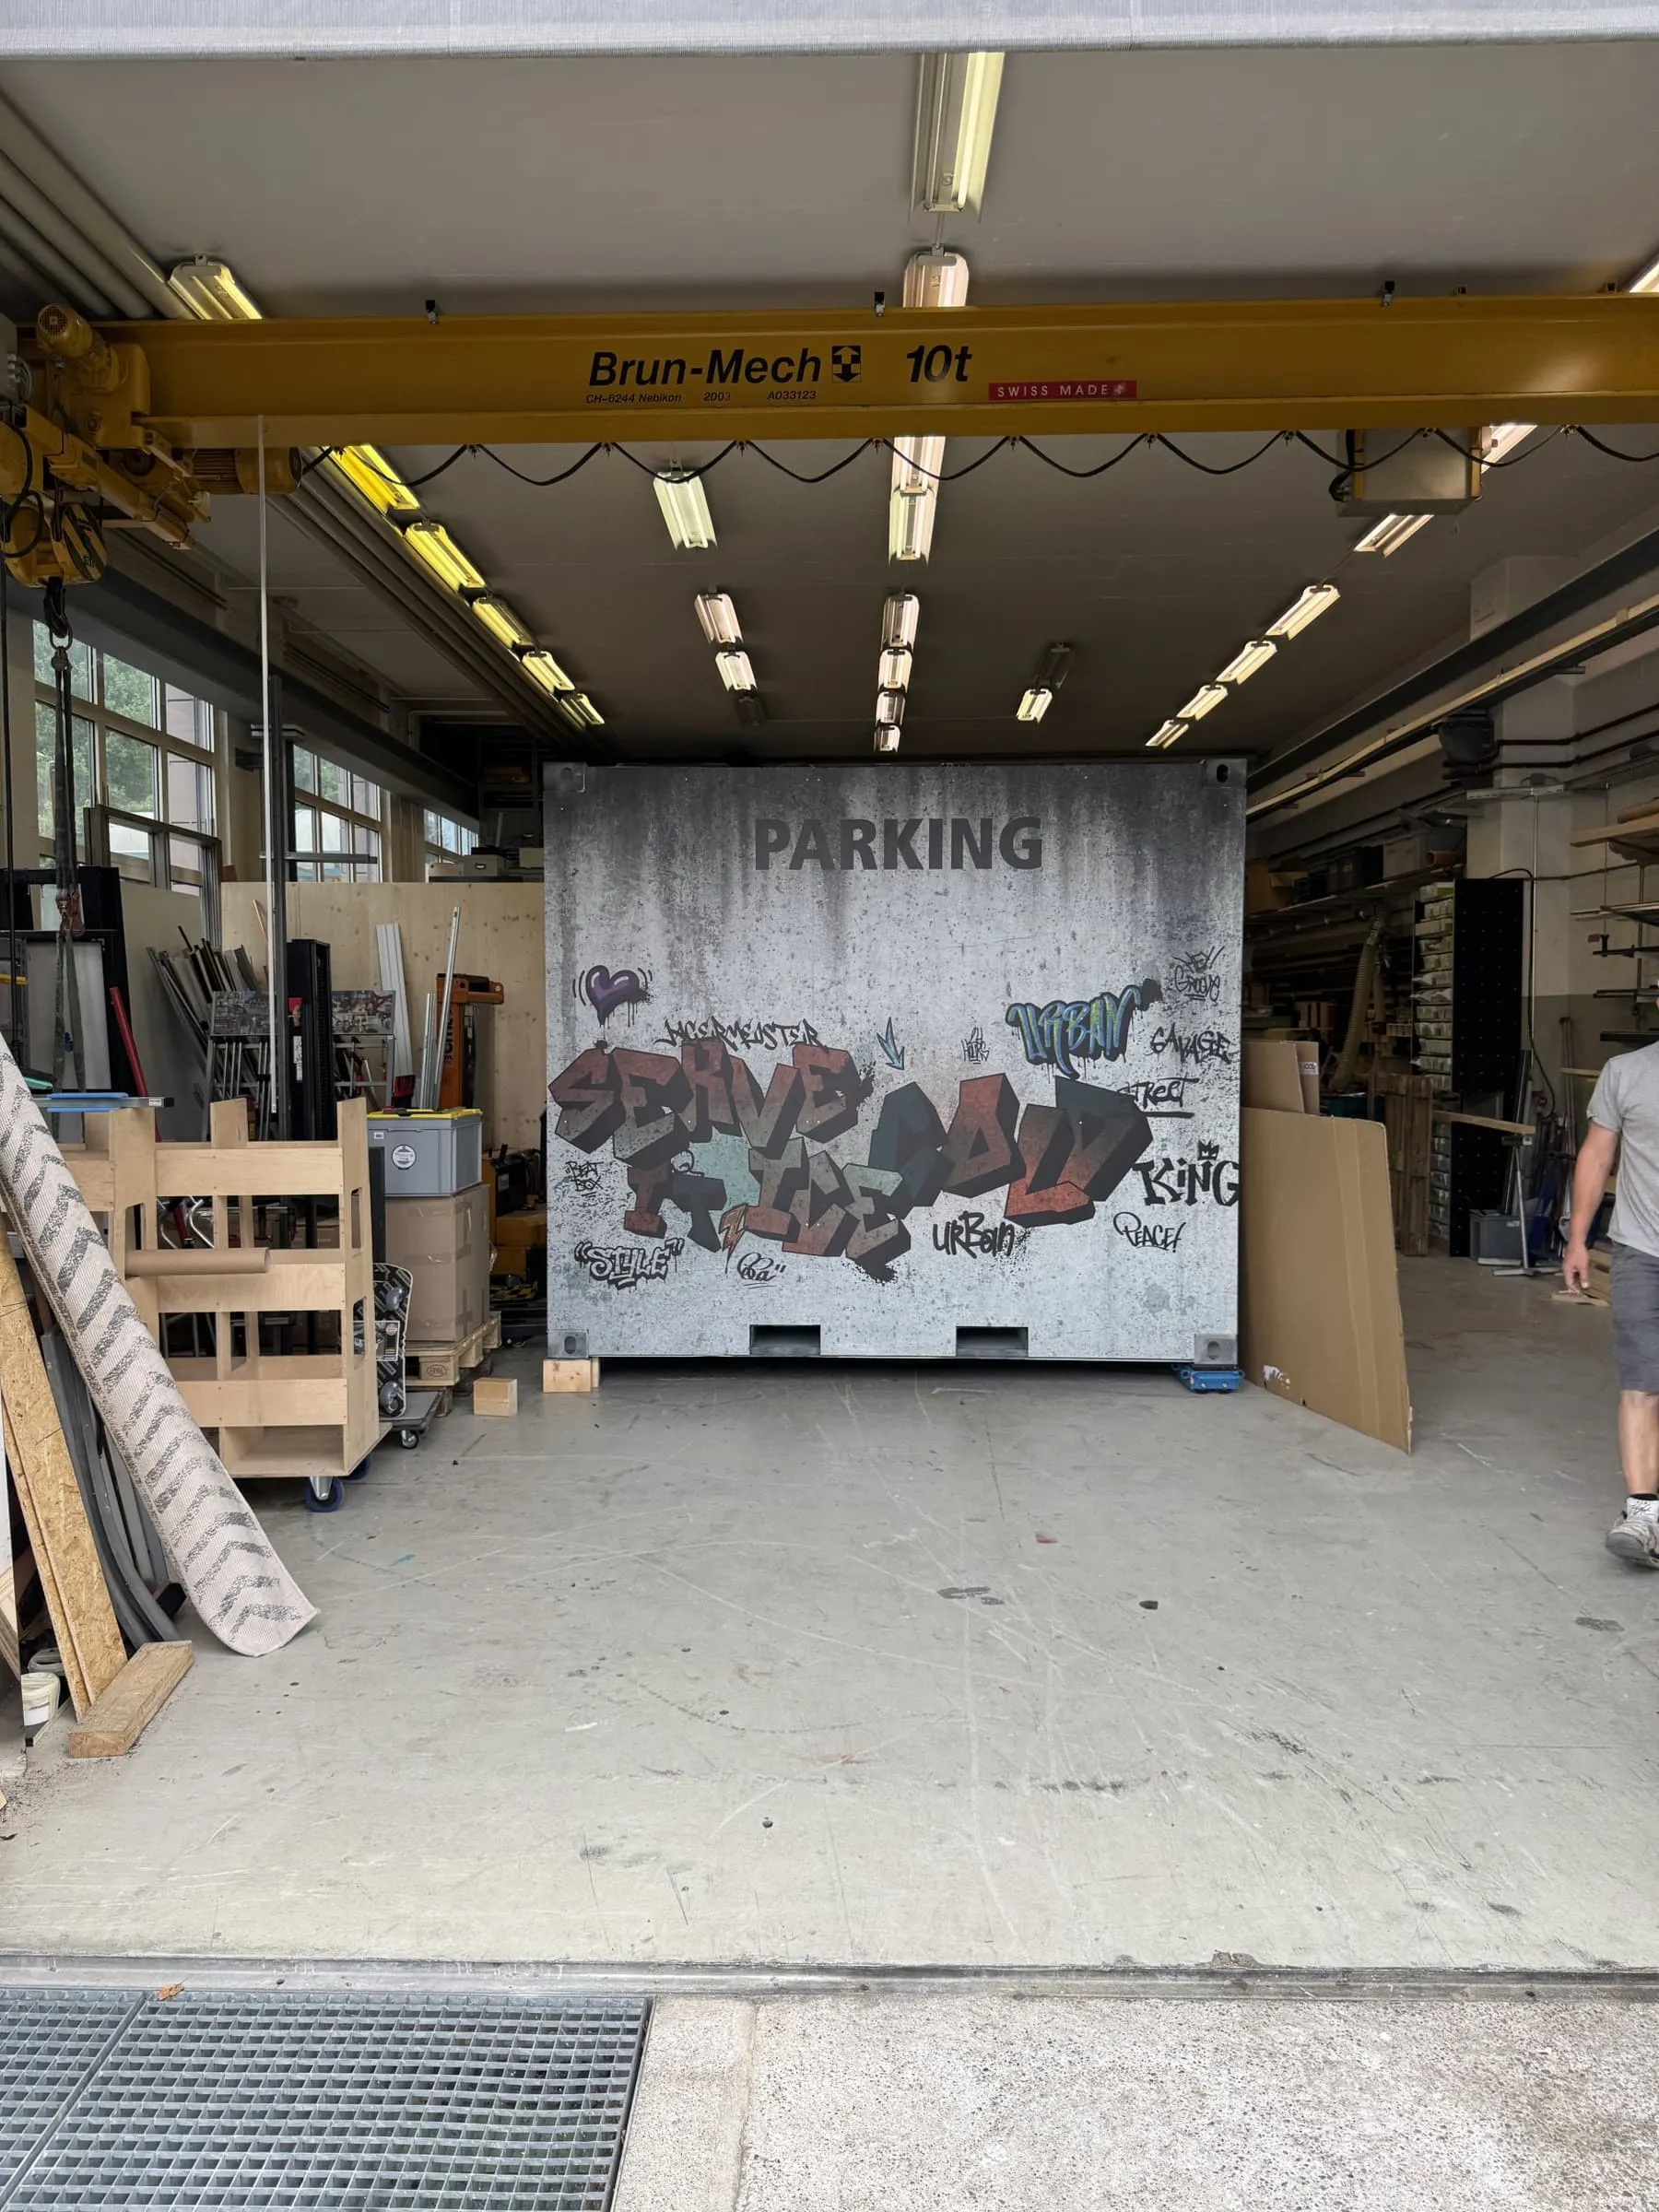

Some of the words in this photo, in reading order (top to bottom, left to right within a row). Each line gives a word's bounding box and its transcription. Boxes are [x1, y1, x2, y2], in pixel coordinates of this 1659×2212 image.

[589, 347, 822, 387] Brun-Mech
[906, 345, 973, 383] 10t
[585, 394, 636, 404] CH-6244
[638, 392, 682, 403] Nebikon
[703, 391, 731, 402] 2003
[767, 390, 817, 400] A033123
[997, 385, 1049, 398] SWISS
[1059, 383, 1108, 396] MADE
[754, 817, 1043, 872] PARKING
